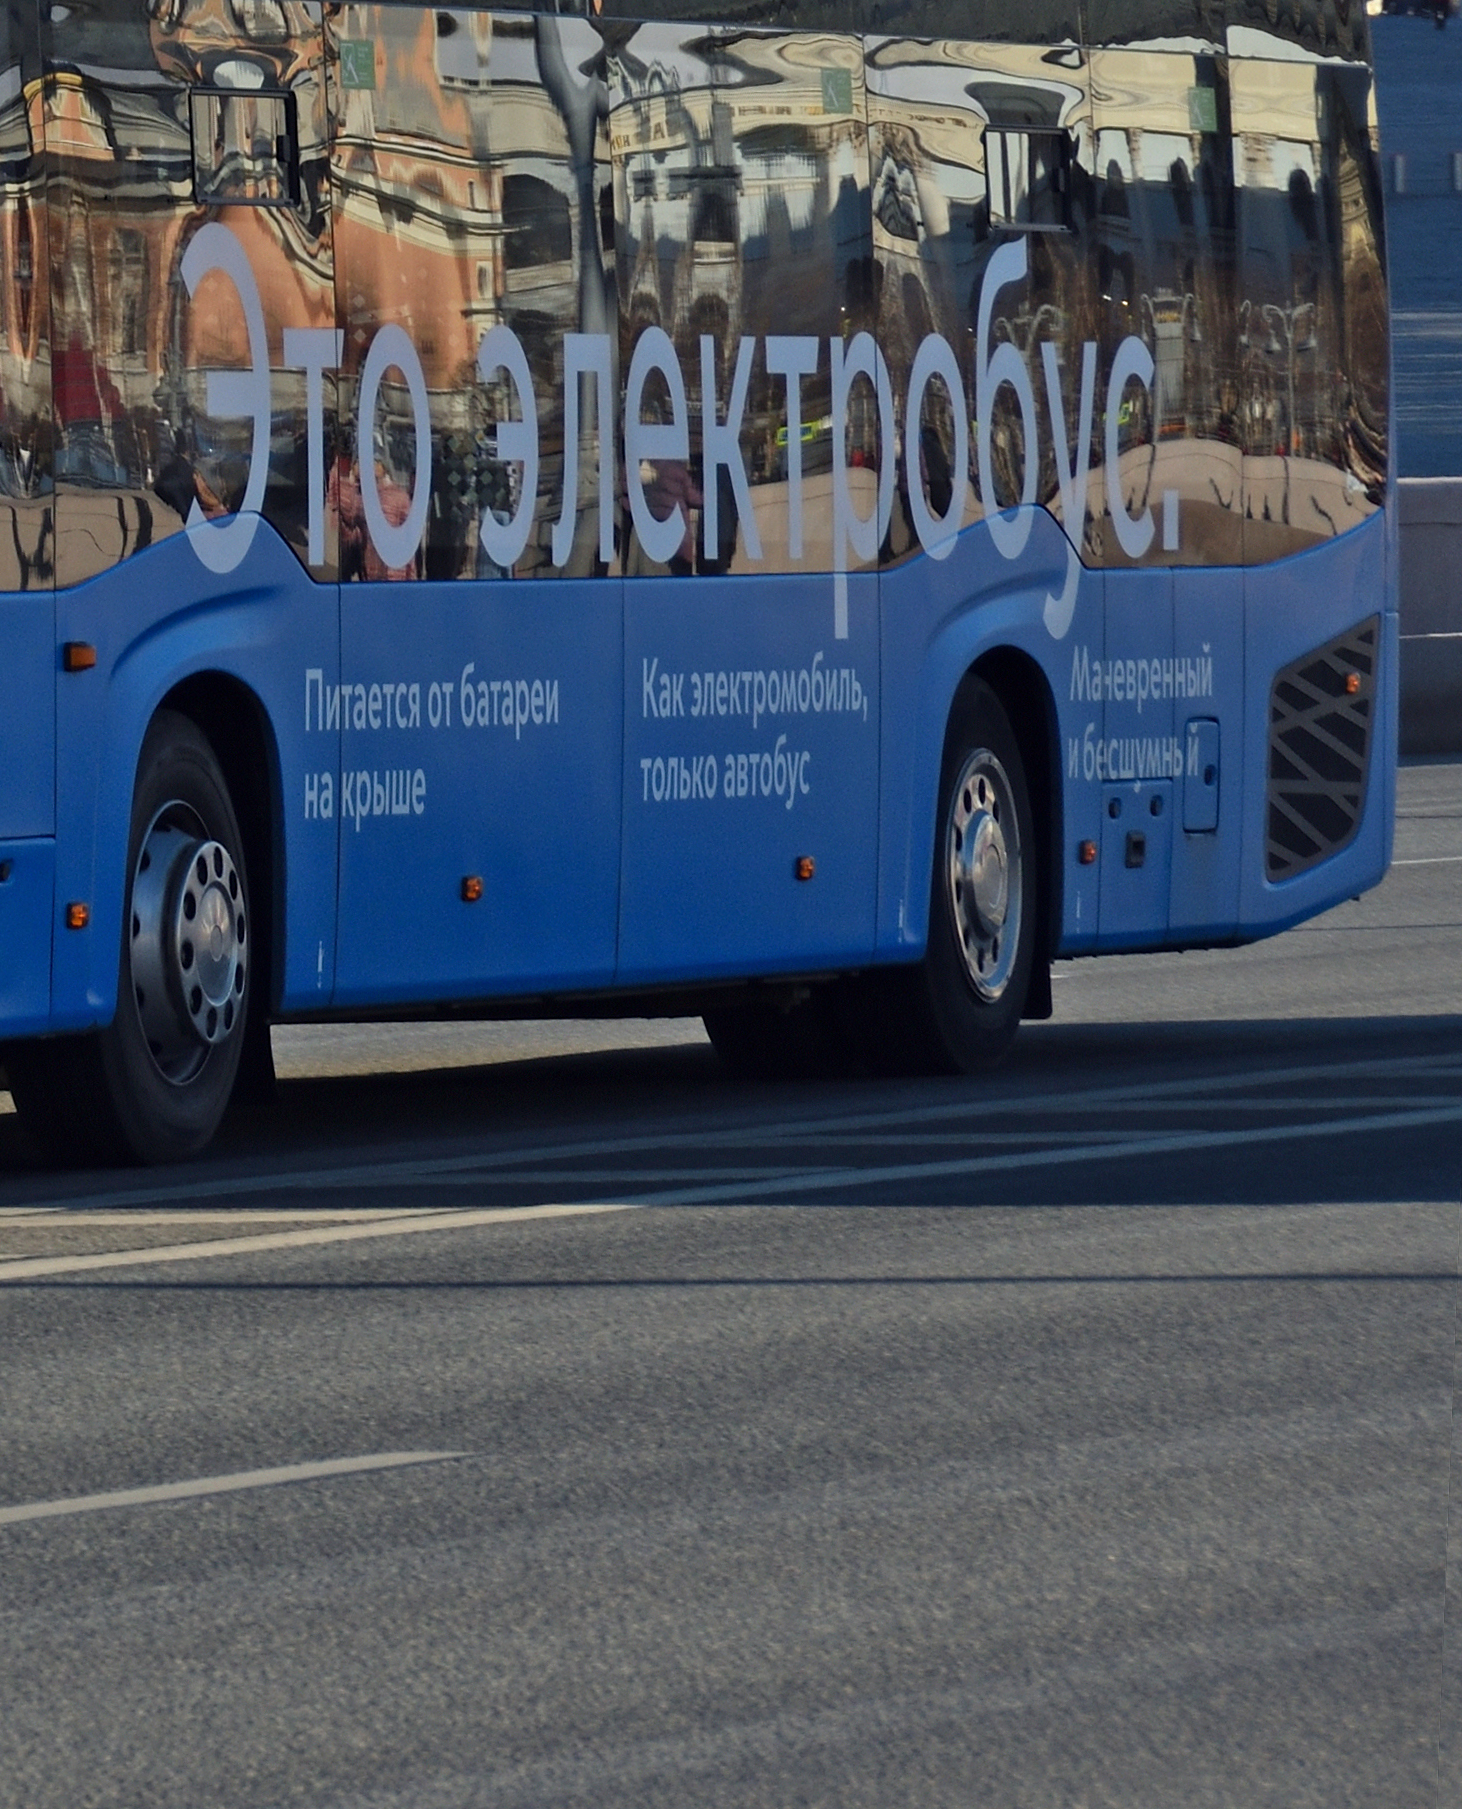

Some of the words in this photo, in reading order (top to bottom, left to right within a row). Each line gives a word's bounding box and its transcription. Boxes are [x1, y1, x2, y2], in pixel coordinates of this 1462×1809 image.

[180, 221, 431, 574] Это
[478, 238, 1180, 642] электробус.
[305, 668, 421, 731] Питается
[428, 681, 454, 728] от
[460, 662, 560, 741] батареи
[643, 657, 685, 718] Как
[690, 650, 868, 729] электромобиль,
[1070, 642, 1213, 714] Маневренный
[640, 754, 718, 802] только
[723, 733, 811, 810] автобус
[1068, 738, 1079, 779] и
[305, 771, 334, 819] на
[341, 768, 427, 833] крыше
